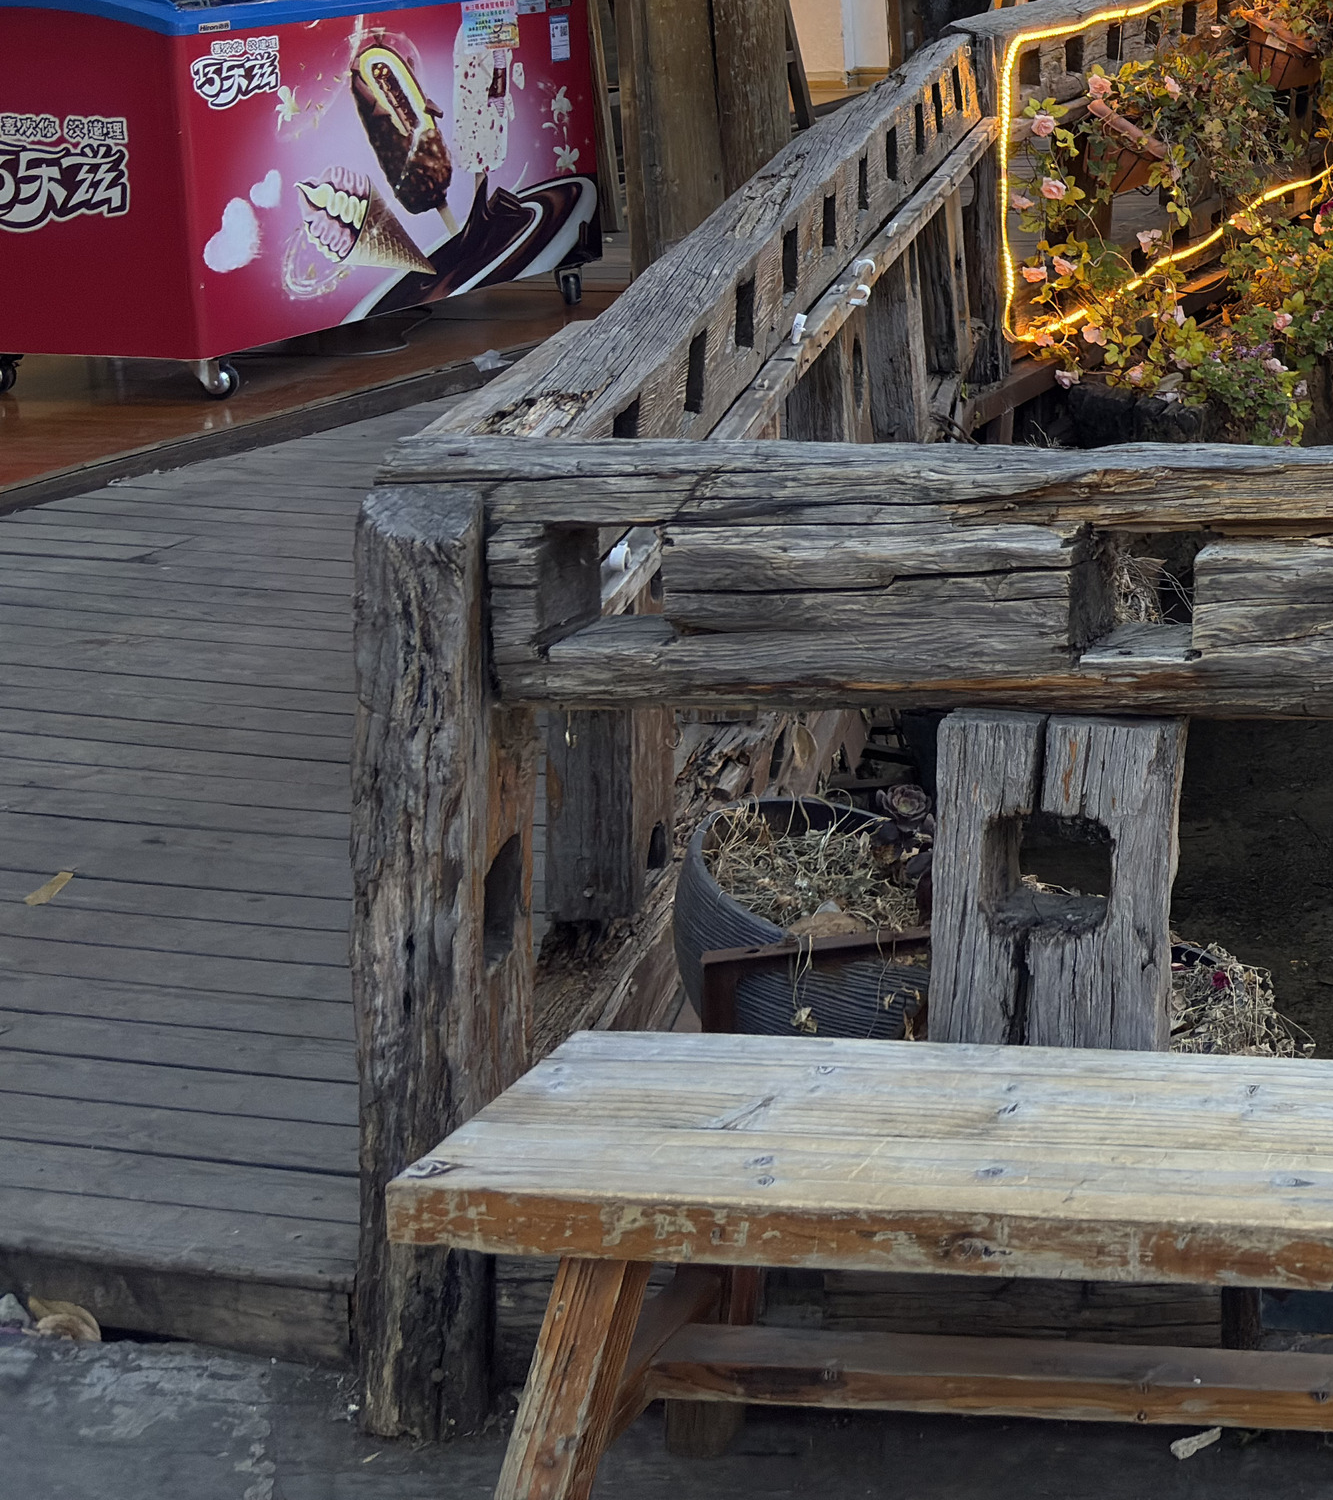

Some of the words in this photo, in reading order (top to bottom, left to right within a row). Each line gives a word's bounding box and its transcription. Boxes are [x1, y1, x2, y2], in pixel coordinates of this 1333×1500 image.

[191, 51, 280, 108] 巧乐兹
[0, 115, 59, 139] 喜欢你
[65, 118, 126, 141] 没道理
